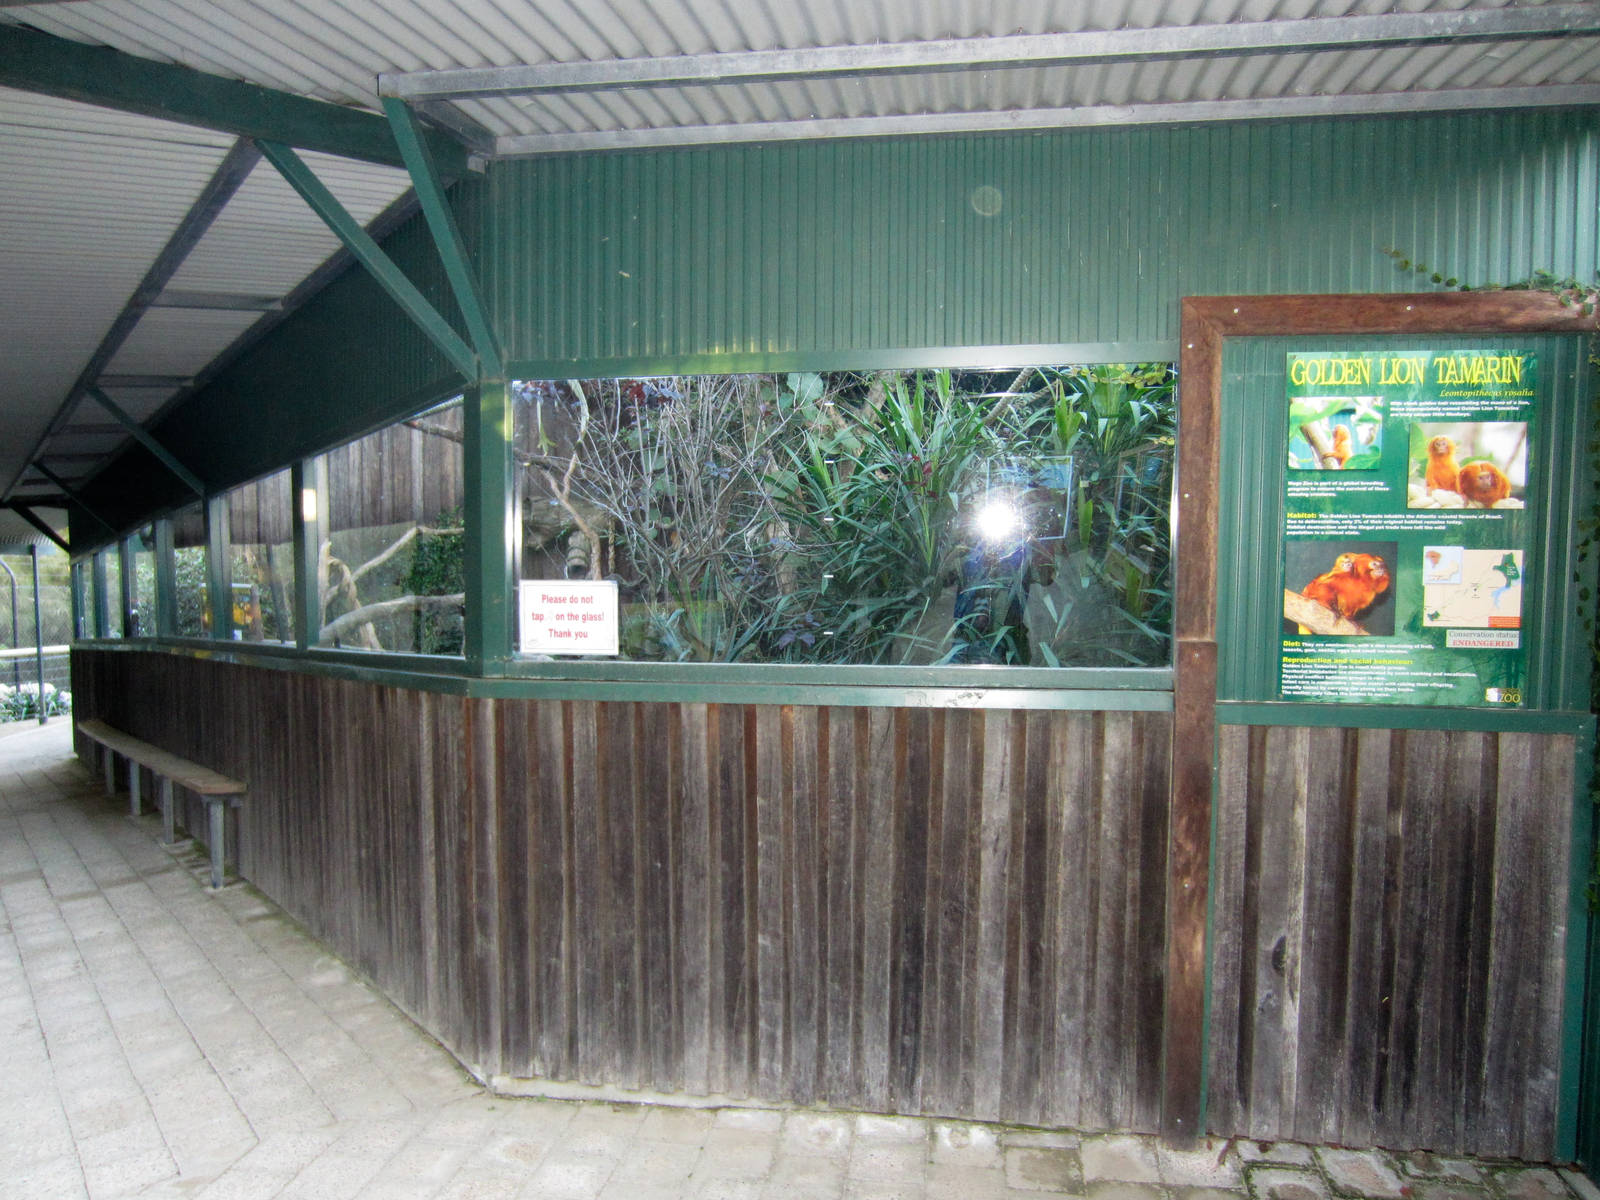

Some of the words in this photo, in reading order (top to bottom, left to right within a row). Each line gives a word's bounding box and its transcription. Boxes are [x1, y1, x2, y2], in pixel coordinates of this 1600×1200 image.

[1291, 358, 1371, 387] GOLDEN
[1378, 357, 1426, 387] LION
[1433, 355, 1522, 387] TAMARIN
[1440, 389, 1502, 399] Leontopithecus
[542, 594, 566, 604] Please
[569, 595, 578, 604] do
[581, 596, 593, 604] not
[532, 612, 544, 622] tap
[568, 612, 579, 621] the
[582, 612, 604, 623] glass!
[548, 628, 572, 638] Thank
[575, 631, 588, 640] you
